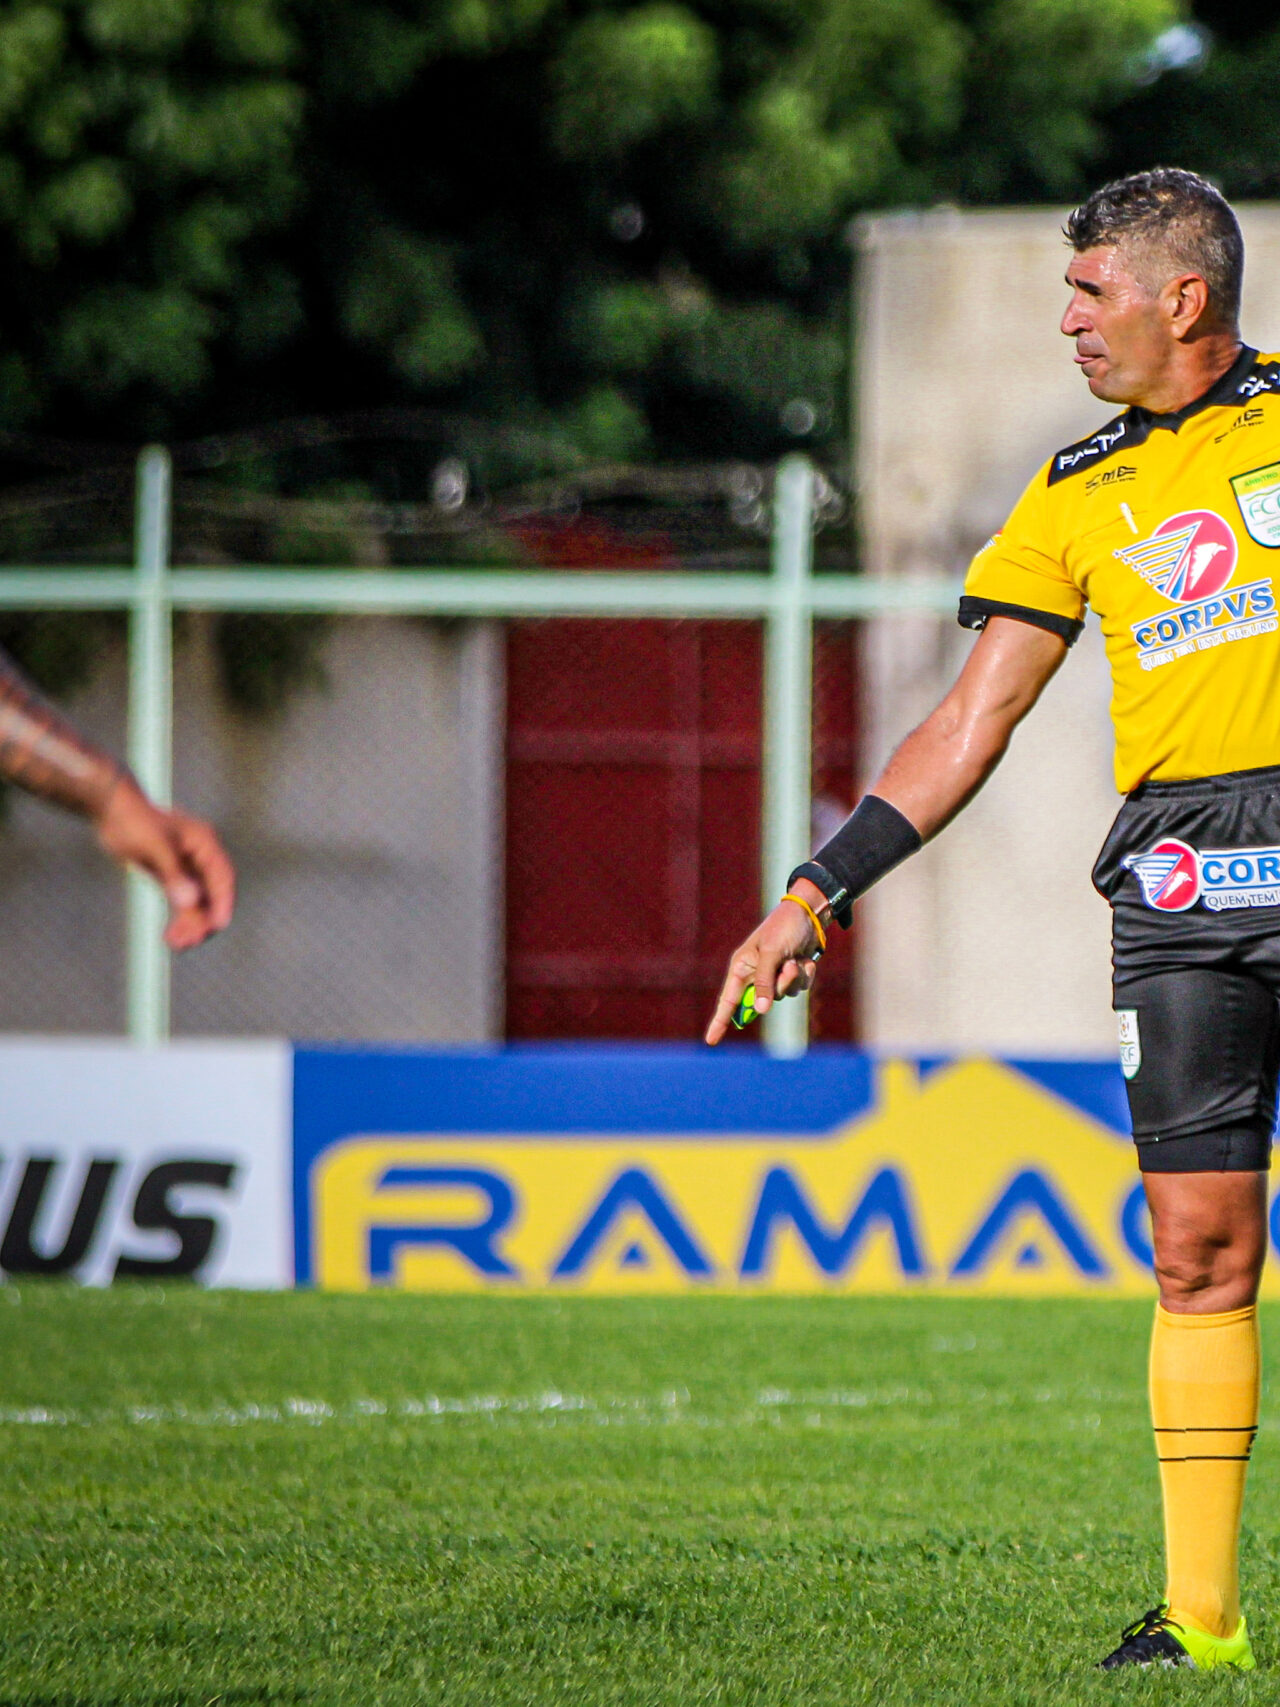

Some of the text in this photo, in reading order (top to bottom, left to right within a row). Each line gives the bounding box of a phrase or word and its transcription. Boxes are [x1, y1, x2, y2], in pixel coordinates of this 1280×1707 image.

[1135, 586, 1275, 649] CORPVS
[1207, 894, 1246, 908] QUEM
[1250, 891, 1277, 904] TEM
